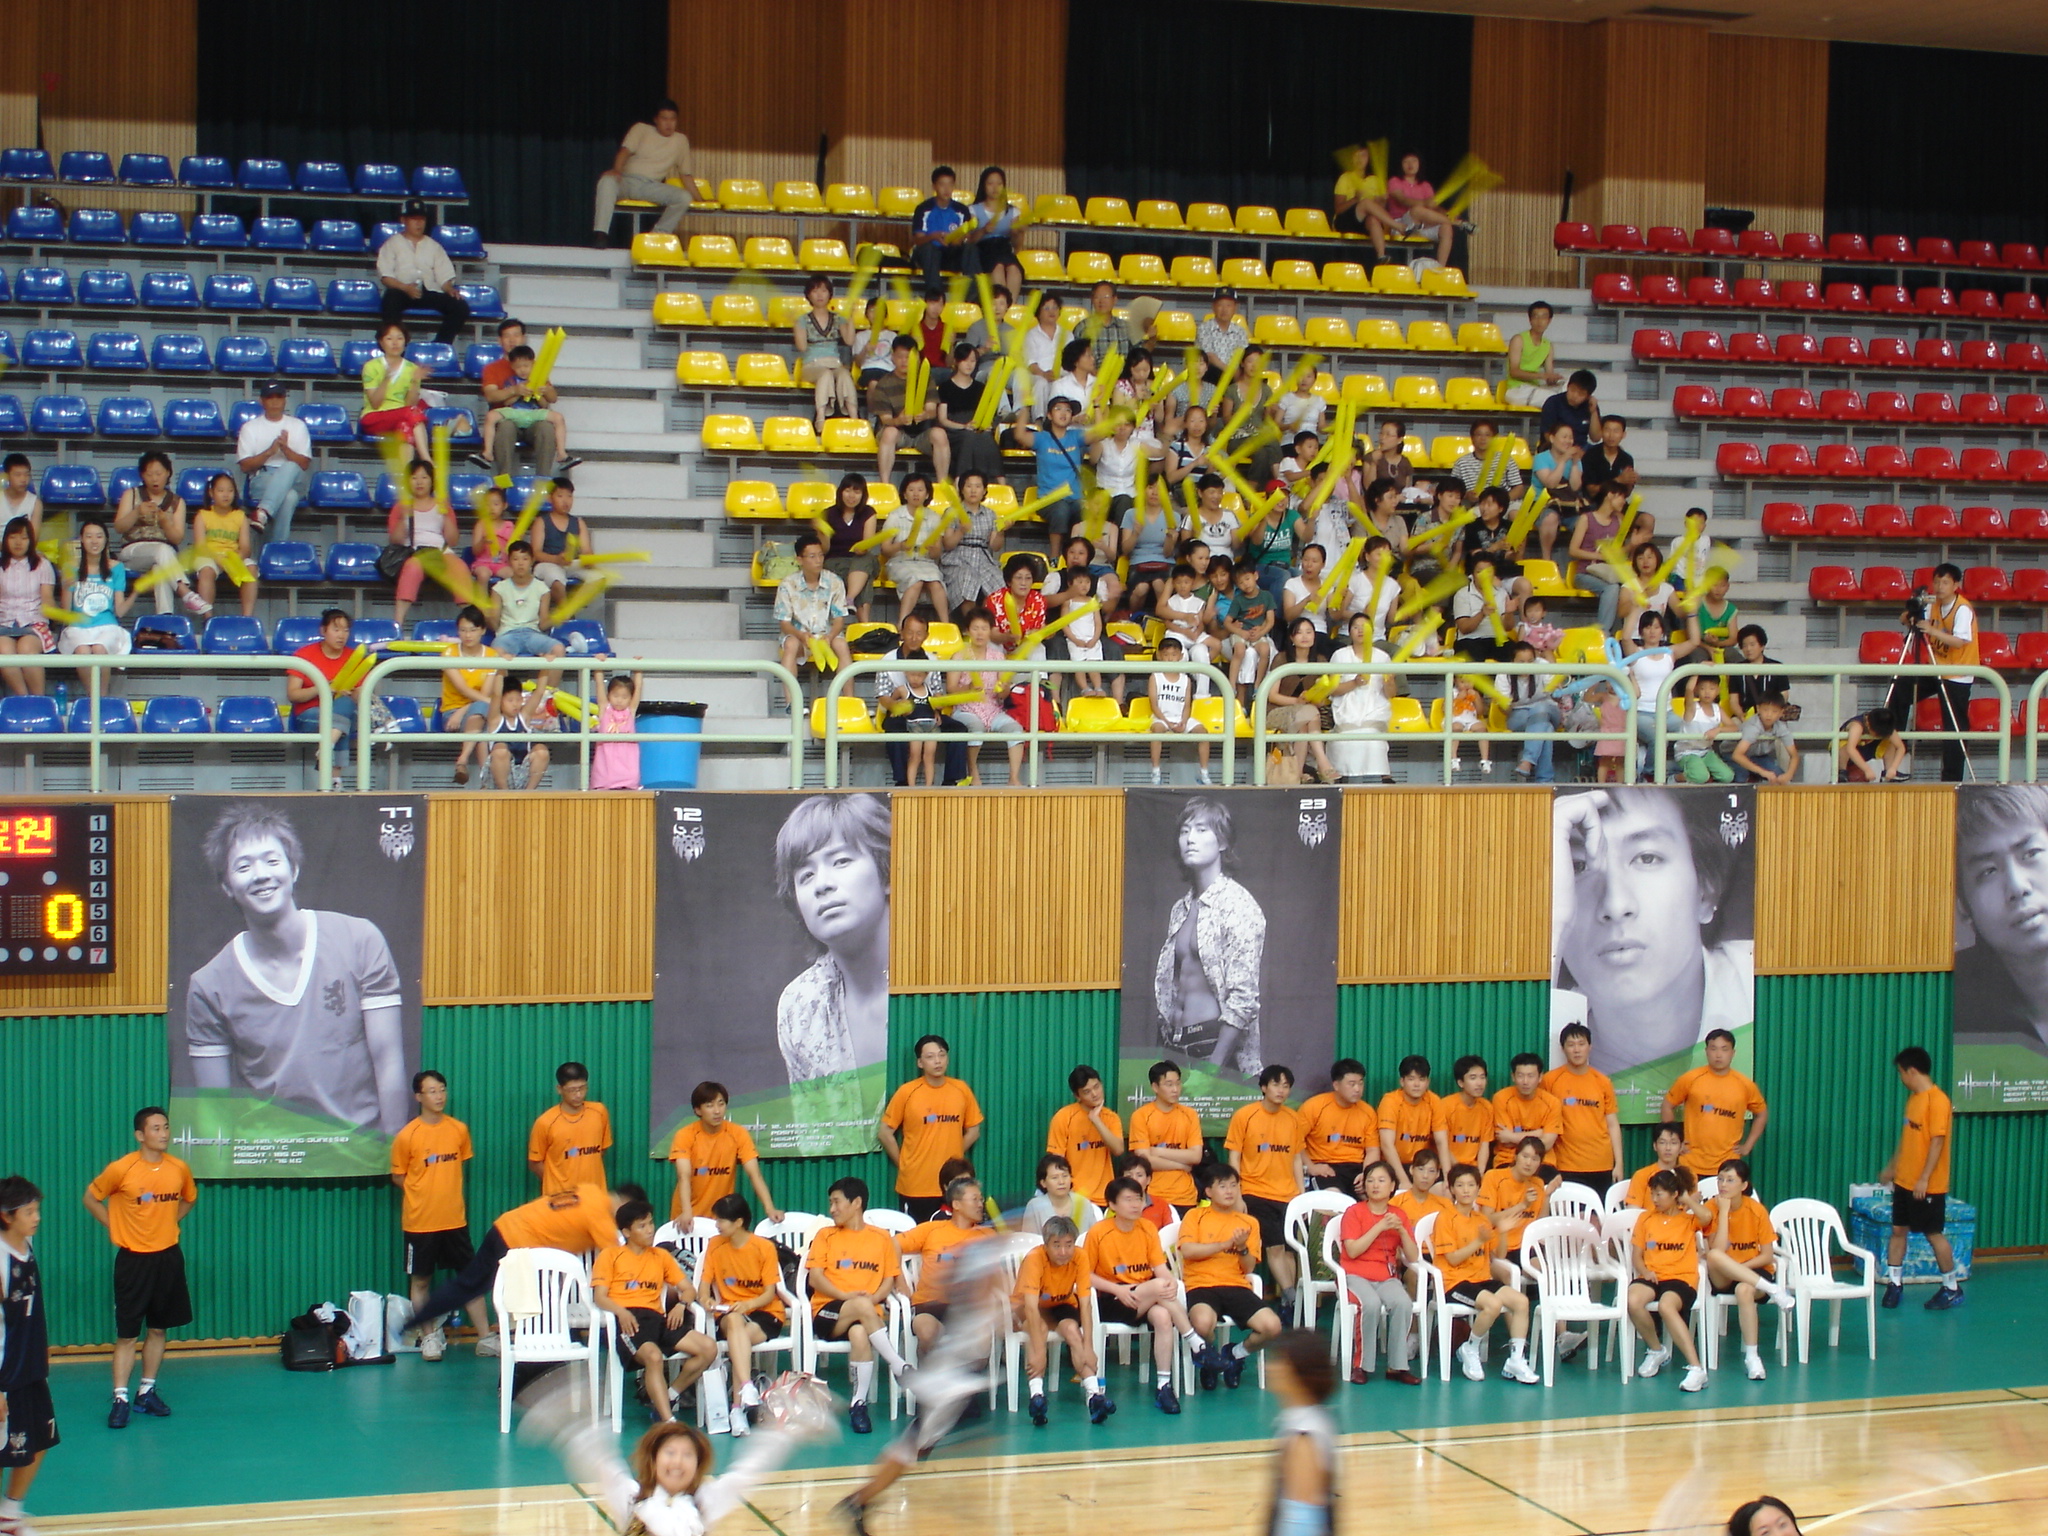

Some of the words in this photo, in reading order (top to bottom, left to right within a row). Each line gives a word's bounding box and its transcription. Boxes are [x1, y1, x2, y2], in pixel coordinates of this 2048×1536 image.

[1162, 684, 1180, 692] HIT
[1157, 694, 1185, 703] STRONG
[1300, 799, 1326, 809] 23
[1728, 794, 1737, 808] 1
[380, 807, 412, 819] 77
[674, 807, 702, 821] 12
[94, 817, 102, 830] 1
[93, 839, 103, 852] 2
[93, 861, 103, 874] 3
[92, 883, 103, 896] 4
[48, 894, 82, 939] 0
[93, 905, 103, 919] 5
[93, 927, 103, 941] 6
[91, 949, 104, 963] 7
[1576, 1098, 1600, 1108] YUMC
[936, 1114, 960, 1123] YUMC
[1713, 1106, 1736, 1119] YUMC
[1340, 1134, 1362, 1144] YUMC
[578, 1145, 601, 1156] YUMC
[1269, 1144, 1291, 1153] YUMC
[436, 1152, 459, 1163] YUMC
[708, 1166, 731, 1176] YUMC
[153, 1192, 180, 1203] YUMC
[1656, 1242, 1685, 1251] YUMC
[1730, 1241, 1757, 1251] YUMC
[852, 1261, 880, 1273] YUMC
[23, 1294, 33, 1317] 7
